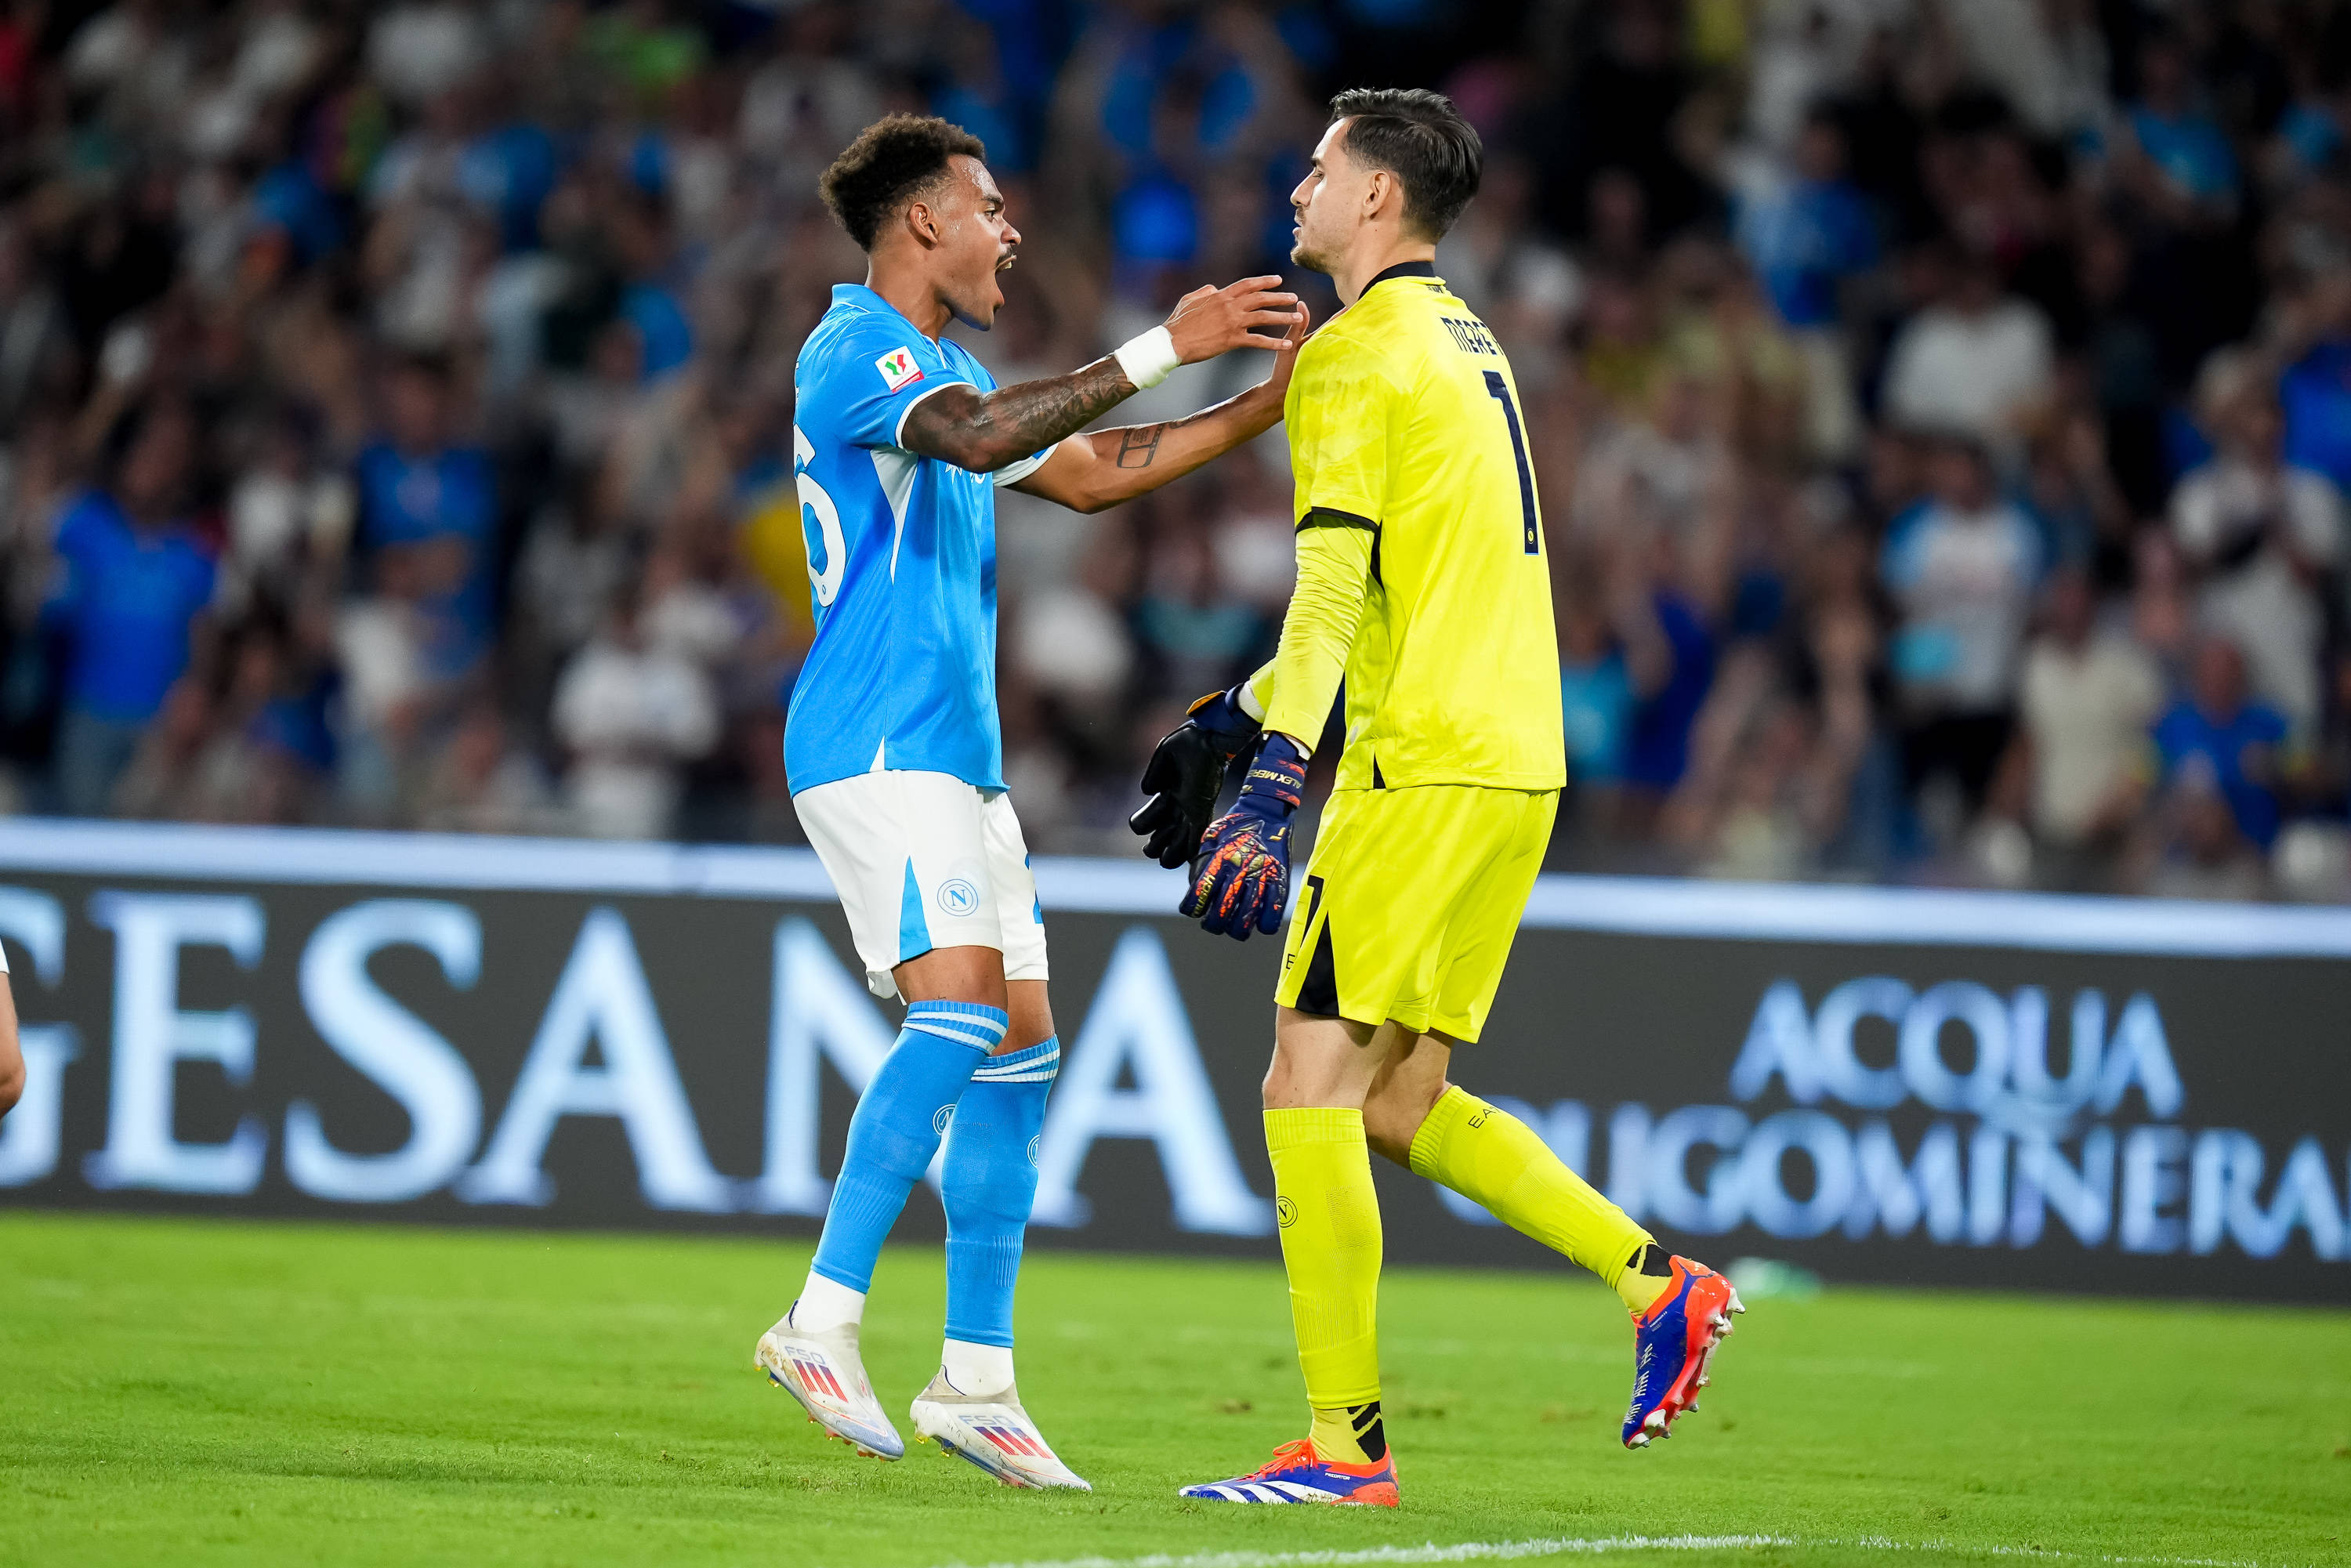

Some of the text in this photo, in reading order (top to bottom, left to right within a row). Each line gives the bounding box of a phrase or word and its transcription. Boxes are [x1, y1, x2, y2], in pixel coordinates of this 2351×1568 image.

[1481, 369, 1539, 556] 1
[949, 889, 967, 907] N
[1728, 973, 2186, 1135] ACQUA
